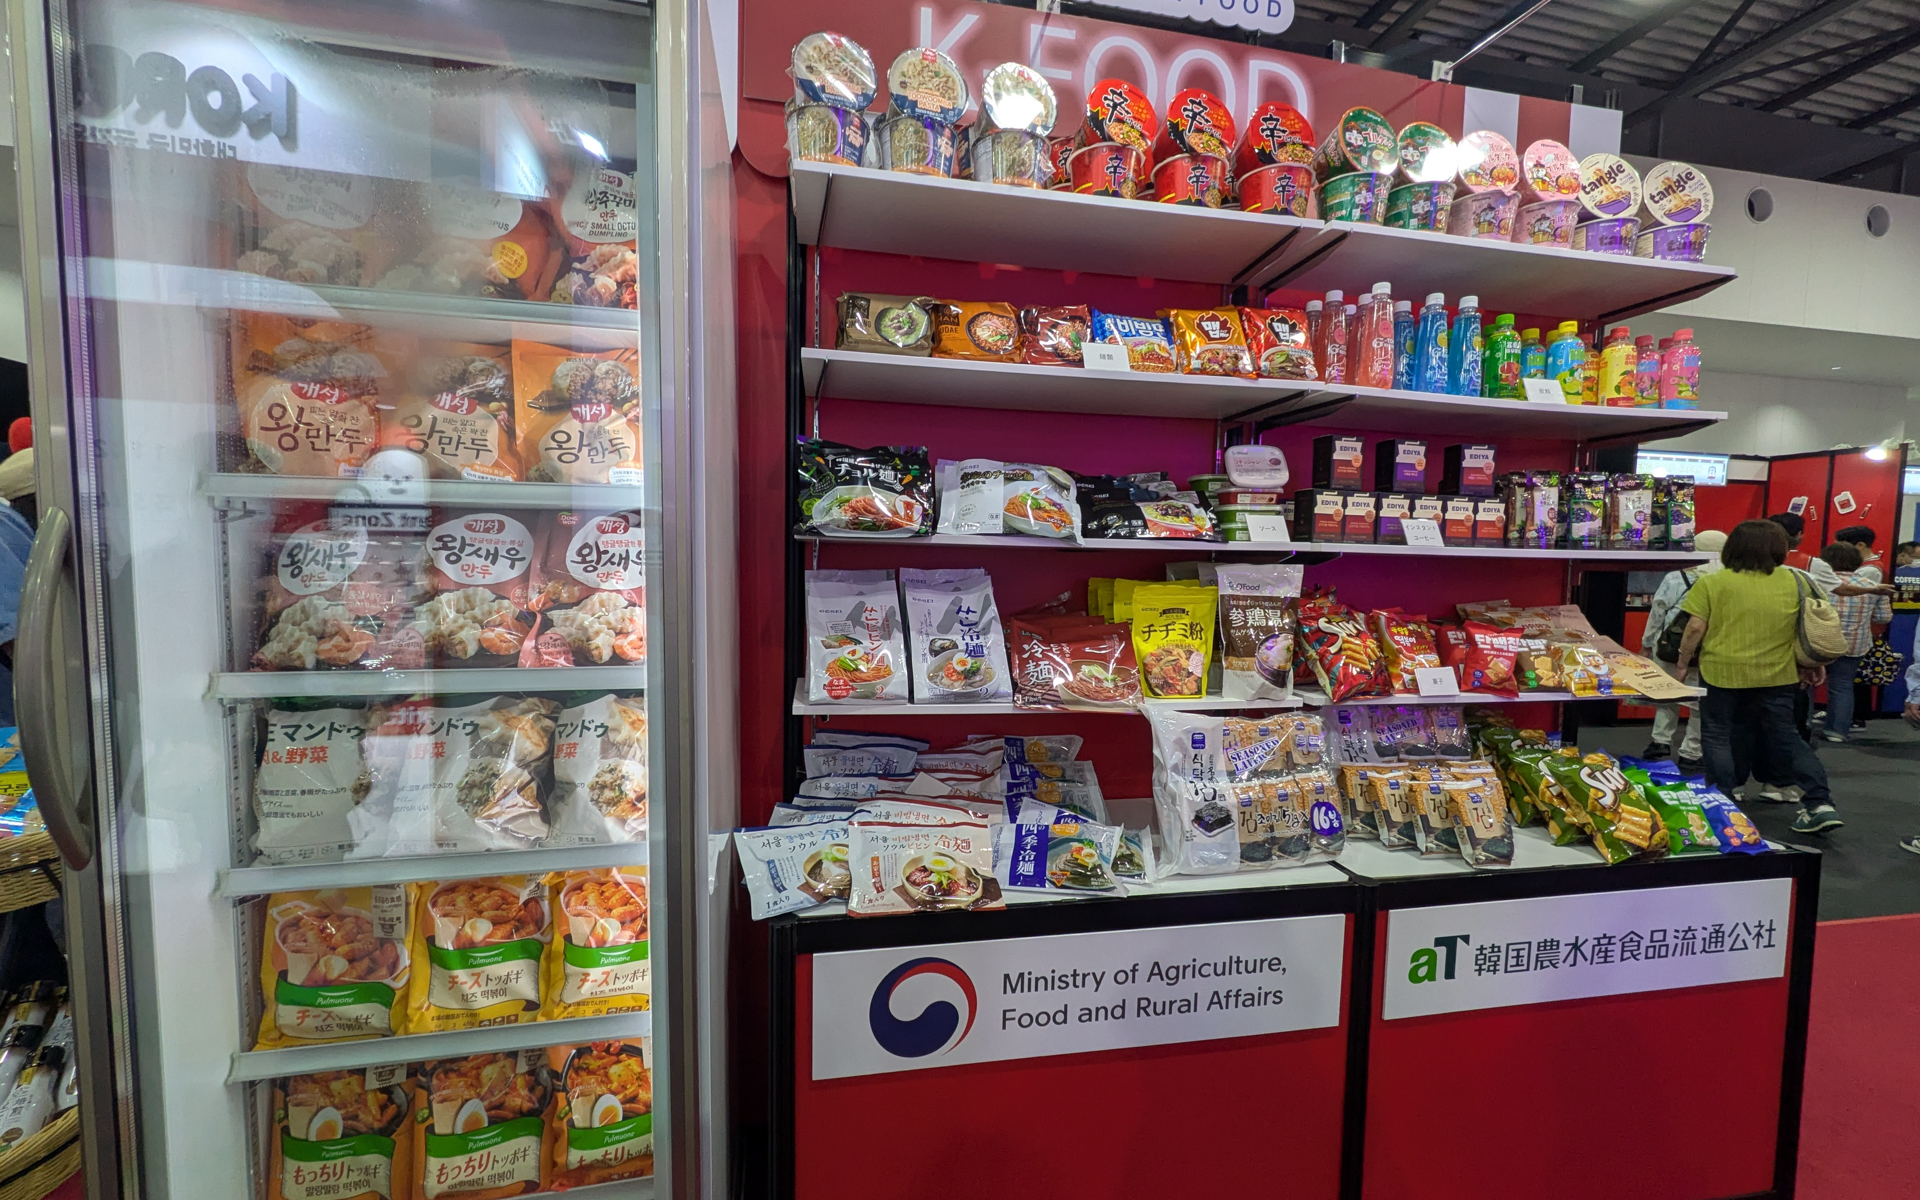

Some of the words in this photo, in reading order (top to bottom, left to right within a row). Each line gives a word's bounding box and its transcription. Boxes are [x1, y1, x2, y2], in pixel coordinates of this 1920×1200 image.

[907, 90, 953, 109] TOOWOOMBA
[917, 99, 941, 112] PASTA
[1102, 87, 1132, 124] 辛
[1182, 98, 1212, 134] 辛
[1259, 113, 1288, 154] 辛
[1105, 153, 1127, 187] 辛
[1187, 163, 1210, 197] 辛
[1581, 163, 1626, 195] tangle
[1274, 173, 1296, 205] 辛
[1650, 169, 1696, 205] tangle
[589, 230, 628, 238] DUMPLING
[591, 222, 615, 231] SMALL
[298, 382, 340, 405] 개성
[435, 393, 469, 415] 개성
[573, 403, 606, 422] 개성
[259, 402, 368, 453] 왕만두
[399, 413, 493, 460] 왕만두
[544, 429, 631, 465] 왕만두
[1339, 445, 1358, 453] EDIYA
[1320, 499, 1339, 507] EDIYA
[1451, 505, 1470, 513] EDIYA
[468, 520, 499, 535] 개성
[599, 520, 629, 534] 개성
[281, 541, 359, 579] 왕새우
[431, 533, 527, 571] 왕새우
[460, 562, 493, 579] 만두
[597, 571, 625, 585] 만두
[1228, 607, 1283, 628] 参鶏湯
[1140, 620, 1205, 643] チヂミ粉
[1317, 615, 1368, 654] Sun
[1022, 639, 1055, 686] 冷麺
[1432, 677, 1444, 685] 菓子
[875, 684, 885, 700] 2
[1376, 718, 1418, 737] SEASONED
[1231, 738, 1280, 763] SEASONED
[1234, 755, 1268, 772] LAVER
[1578, 764, 1628, 811] Sun
[874, 810, 891, 821] 서울
[894, 811, 930, 823] 비빔냉면
[761, 835, 782, 849] 서울
[788, 840, 818, 853] ソウル
[870, 835, 889, 844] 서울
[892, 833, 930, 843] 비빔냉면
[934, 834, 972, 854] 冷麺
[883, 842, 931, 852] ソウルビビン
[1015, 823, 1039, 876] 四季冷麺
[766, 895, 790, 909] 1食入り
[1473, 918, 1777, 977] 韓国農水産食品流通公社
[468, 954, 503, 966] Pulmuone
[600, 955, 631, 965] Pulmuone
[1408, 933, 1471, 984] aT
[448, 968, 525, 991] チーズトッポギ
[576, 967, 650, 991] チーズトッポギ
[1002, 966, 1106, 995] Ministry
[1113, 963, 1139, 986] of
[1147, 953, 1287, 987] Agriculture,
[316, 996, 354, 1006] Pulmuone
[461, 991, 478, 1003] 치즈
[480, 987, 508, 1001] 떡볶이
[1001, 1003, 1068, 1030] Food
[1077, 998, 1127, 1023] and
[1135, 992, 1199, 1018] Rural
[1206, 985, 1284, 1012] Affairs
[467, 1135, 502, 1150] Pulmuone
[603, 1131, 635, 1144] Pulmuone
[293, 1160, 383, 1185] もっちりトッポギ
[436, 1145, 531, 1185] もっちりトッポギ
[487, 1168, 515, 1185] 떡볶이
